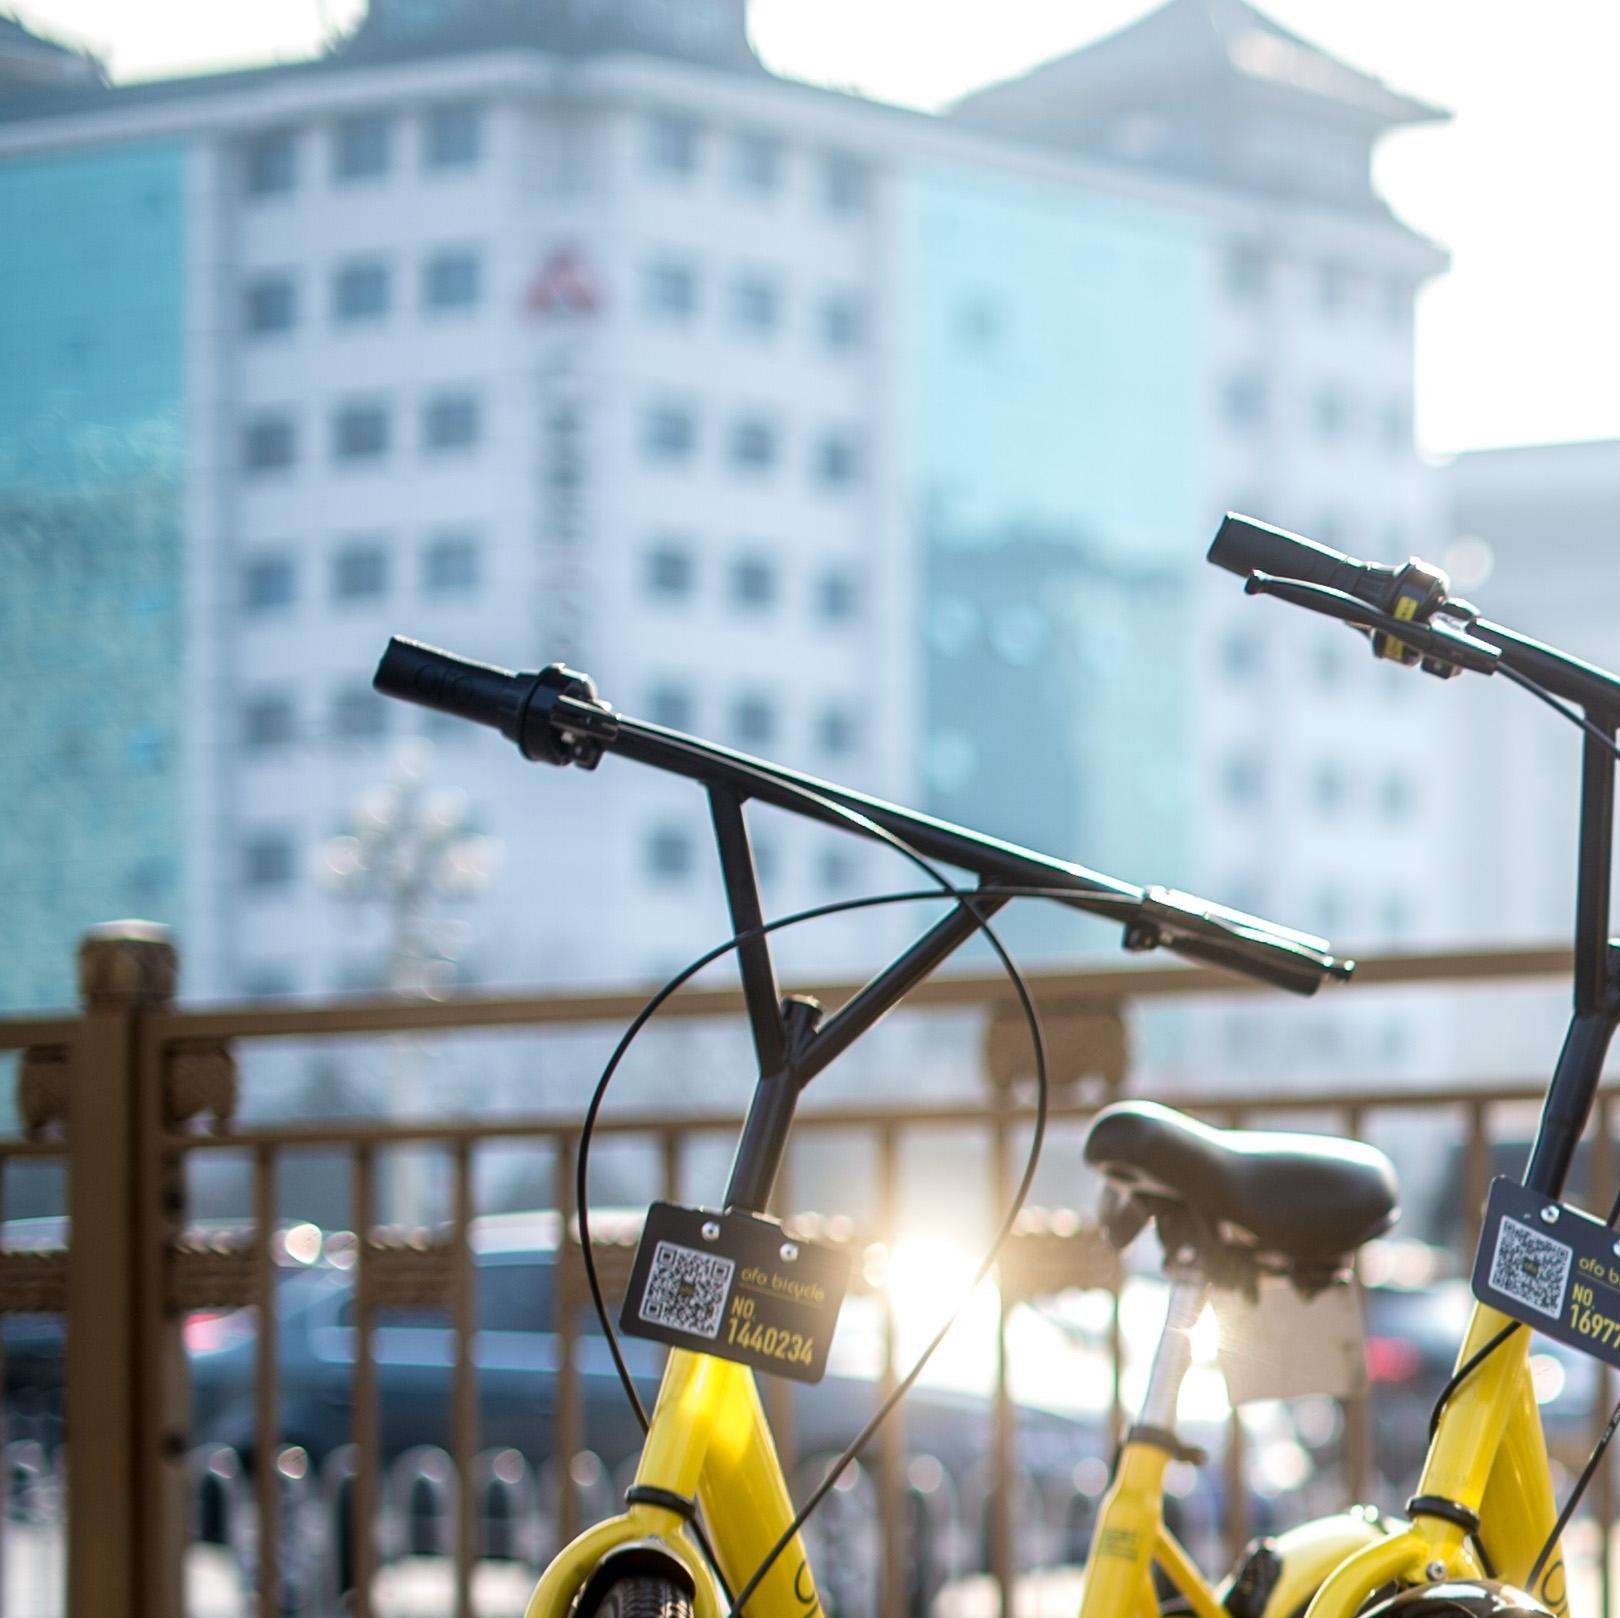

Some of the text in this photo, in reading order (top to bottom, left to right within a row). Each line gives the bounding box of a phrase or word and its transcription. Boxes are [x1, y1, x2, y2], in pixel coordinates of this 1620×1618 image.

[740, 1267, 825, 1301] ofo bicycle
[1579, 1258, 1605, 1277] ofo
[727, 1319, 815, 1366] 1440234
